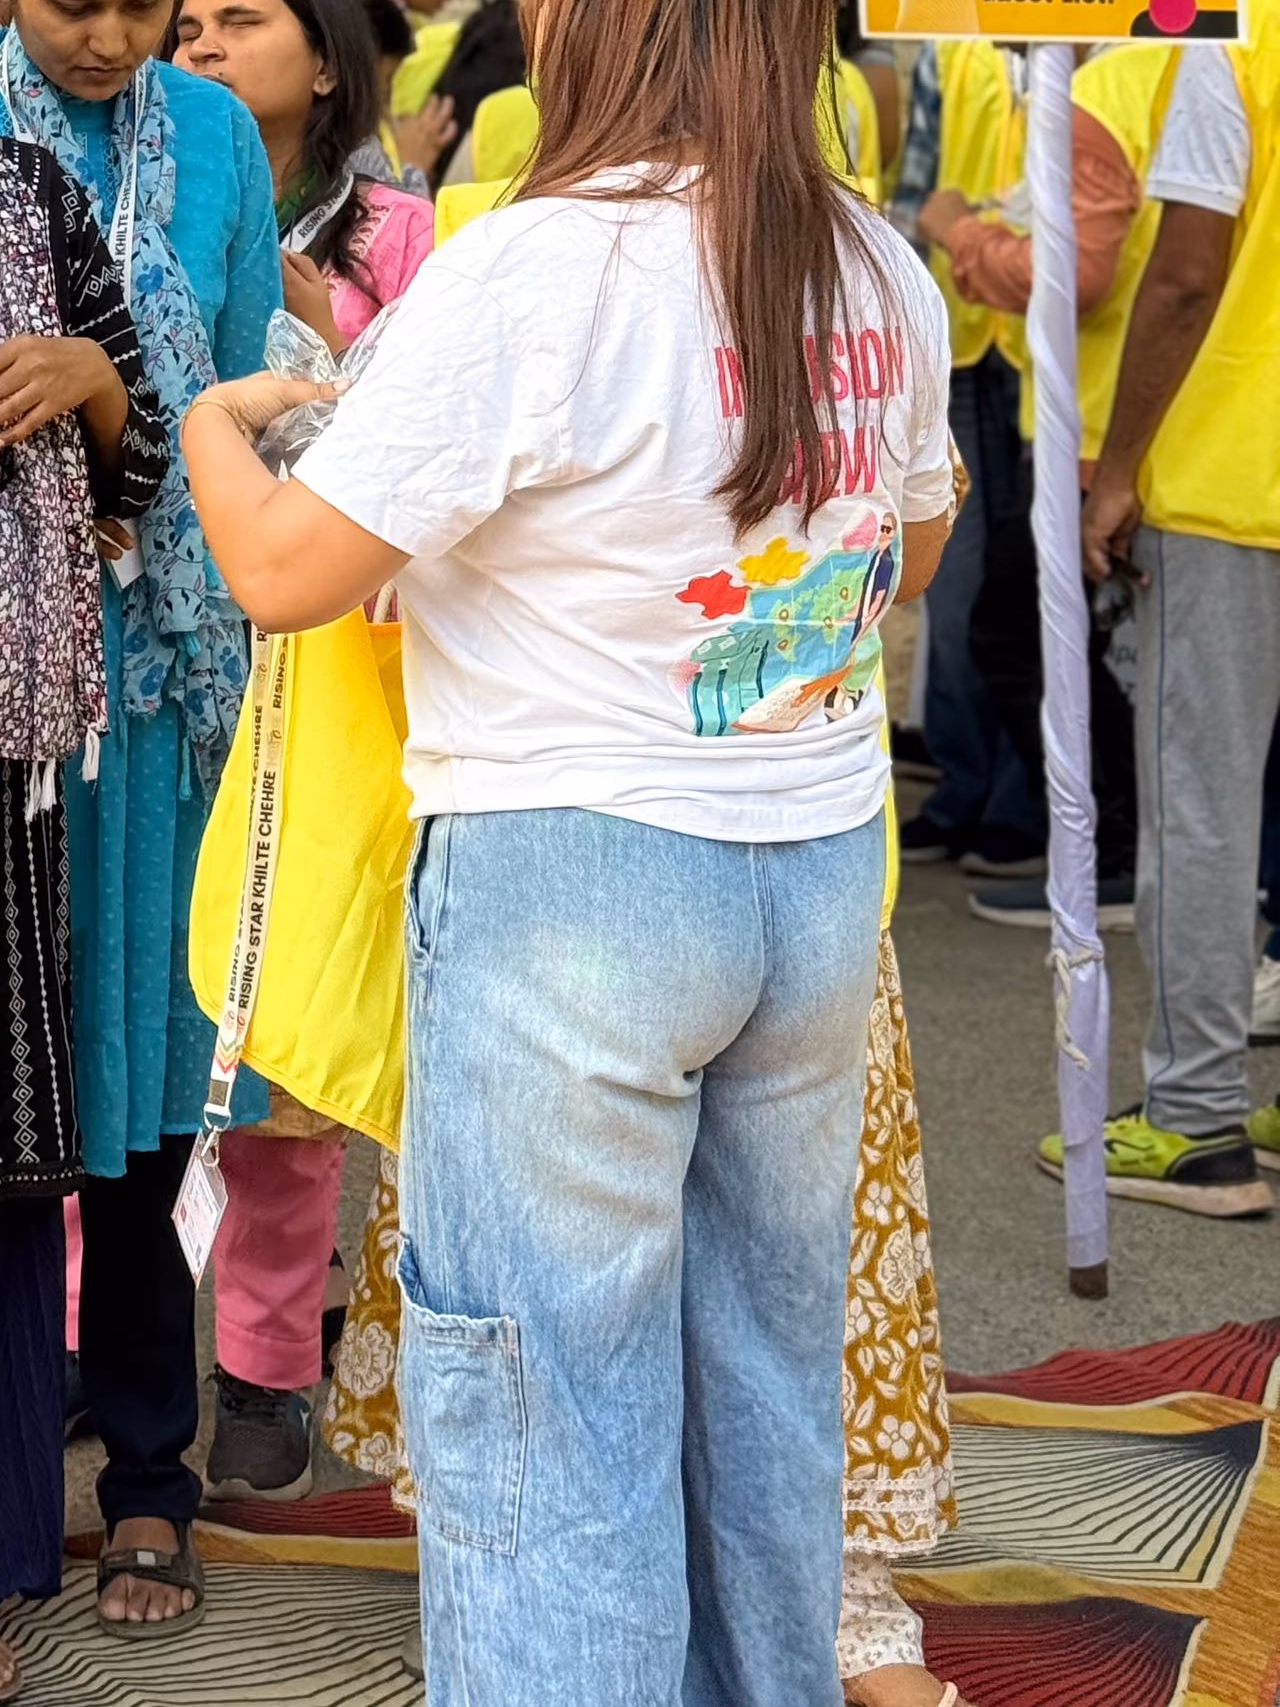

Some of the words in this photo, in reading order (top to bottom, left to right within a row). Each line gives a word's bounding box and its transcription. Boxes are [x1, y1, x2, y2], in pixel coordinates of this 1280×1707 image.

[115, 213, 129, 256] KHILTE
[297, 207, 326, 239] RISING
[714, 326, 904, 417] INUSION
[272, 652, 286, 710] RISING
[259, 770, 277, 837] CHEHRE
[252, 840, 271, 899] KHILTE
[249, 902, 265, 947] STAR
[228, 945, 241, 1002] RISING
[238, 950, 257, 1010] RISING
